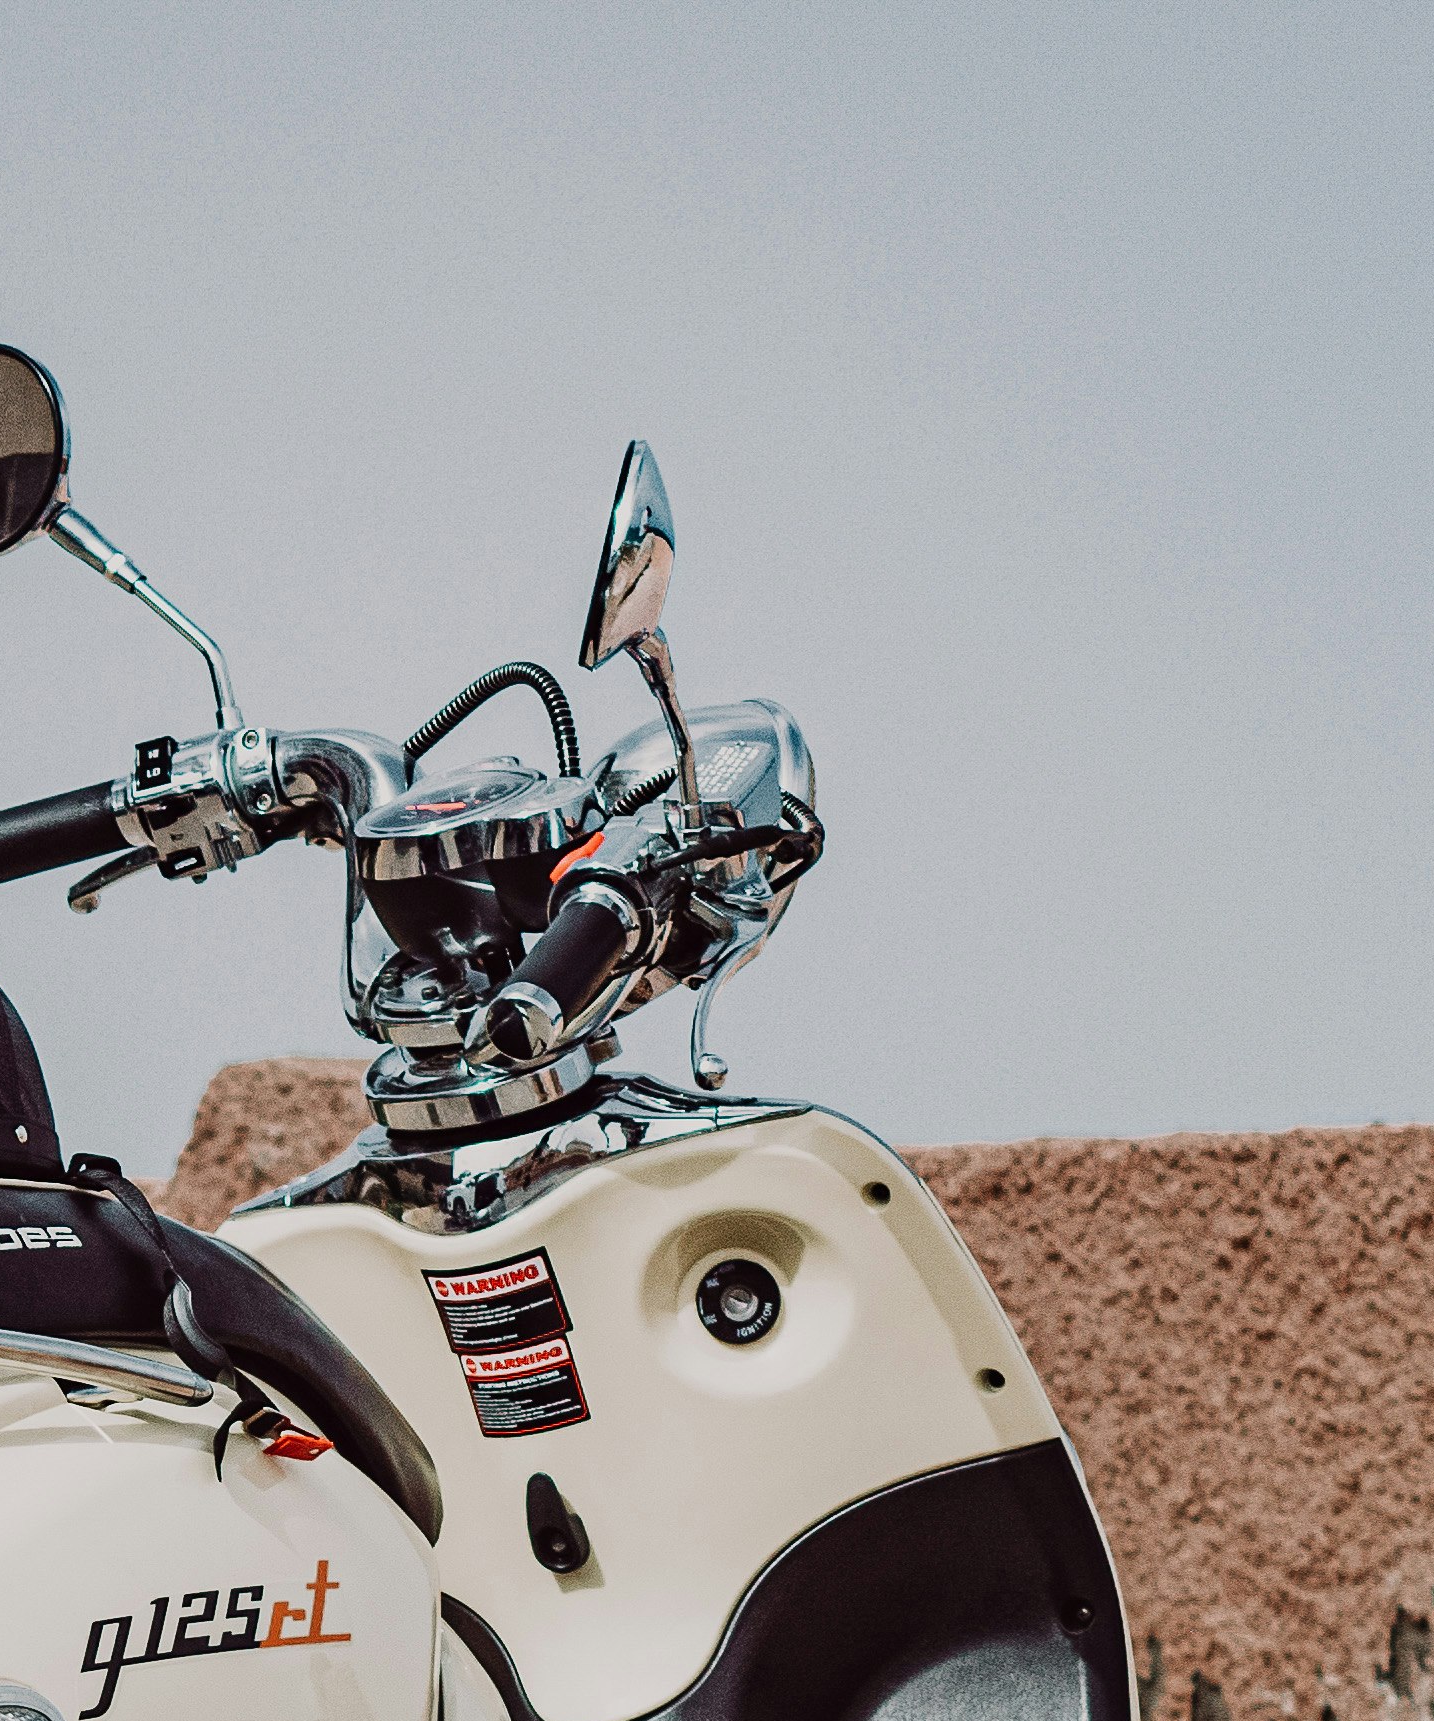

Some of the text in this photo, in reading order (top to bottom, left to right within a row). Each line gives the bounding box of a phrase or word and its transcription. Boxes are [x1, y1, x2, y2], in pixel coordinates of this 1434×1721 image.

[450, 1263, 539, 1297] WARNING
[736, 1302, 773, 1338] IGNITION
[480, 1346, 563, 1372] WARNING
